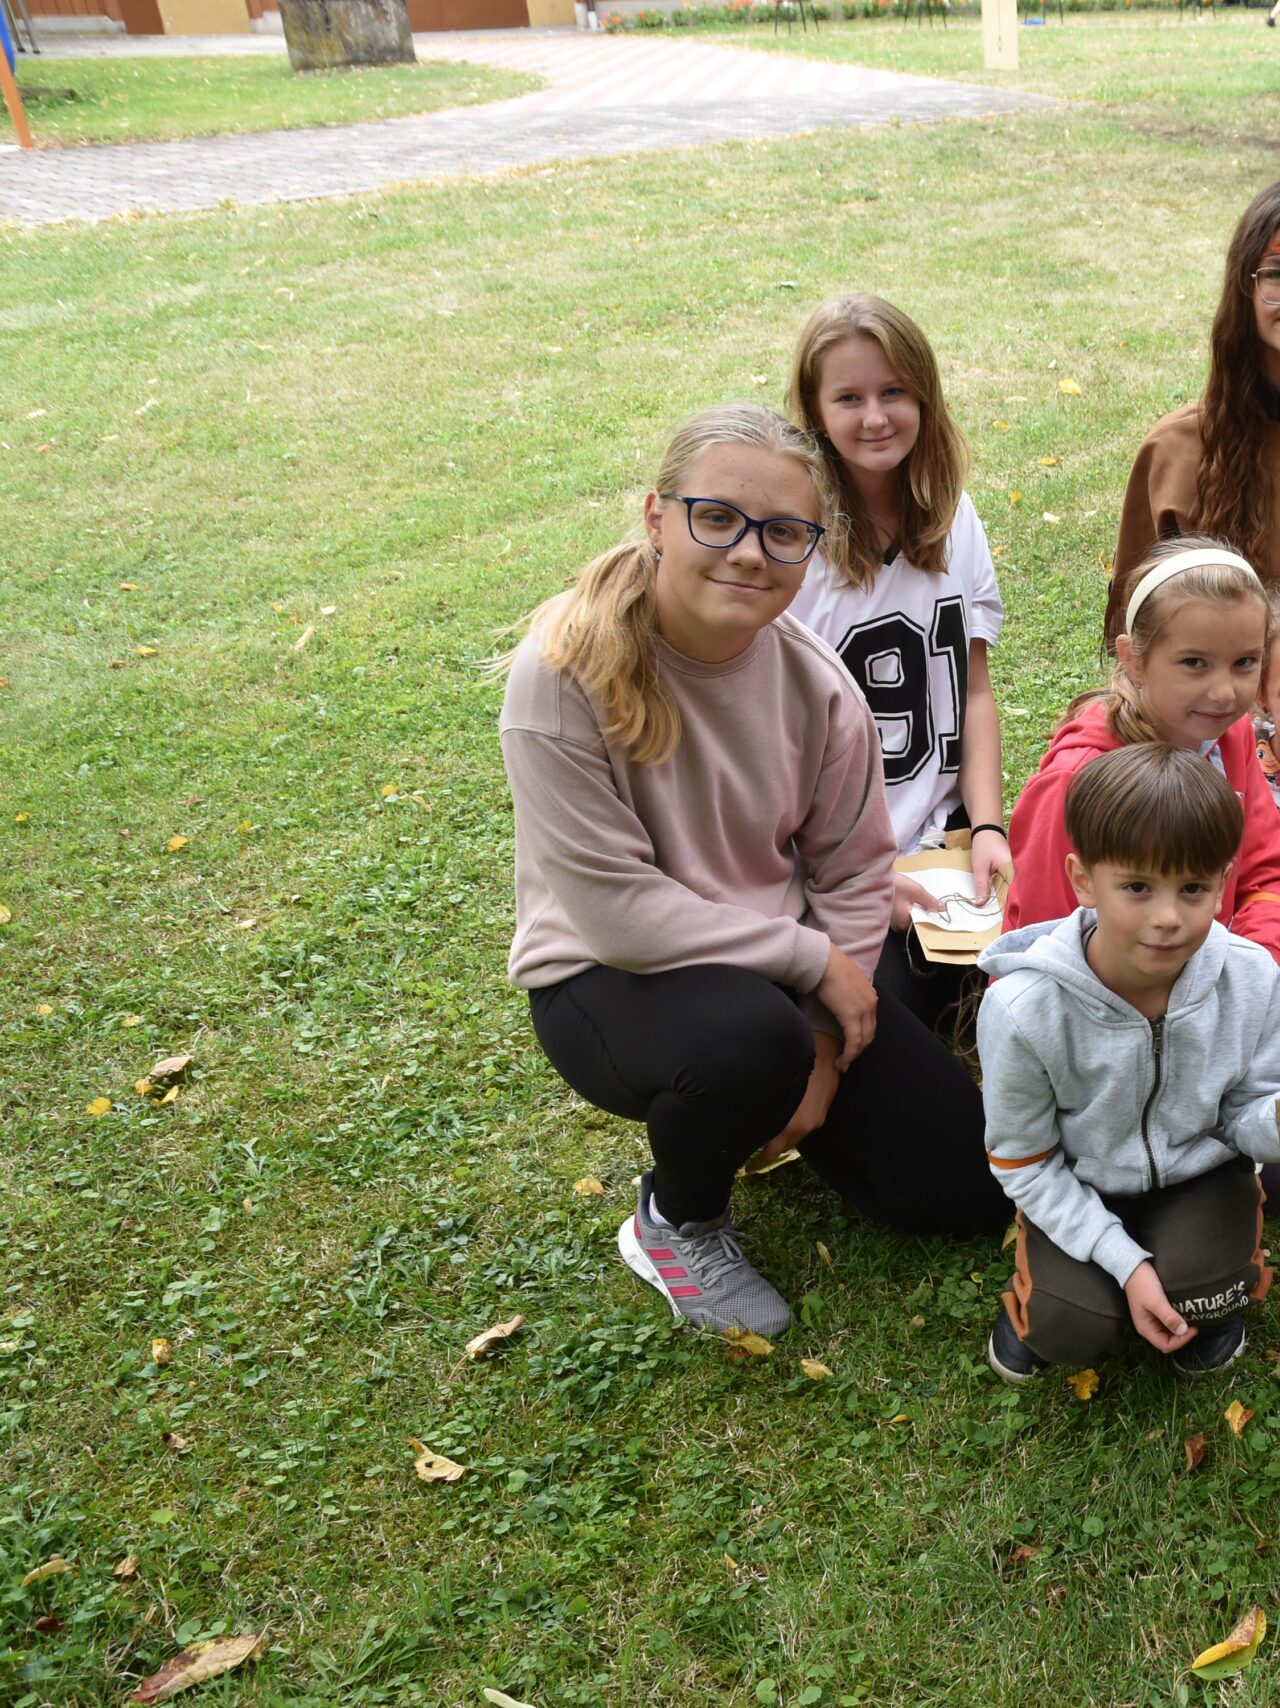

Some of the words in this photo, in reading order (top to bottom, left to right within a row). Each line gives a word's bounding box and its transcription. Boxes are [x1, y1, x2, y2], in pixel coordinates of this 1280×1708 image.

[834, 594, 968, 786] 91
[1172, 1281, 1245, 1314] NATURE'S
[1184, 1295, 1249, 1321] LAYGROUND
